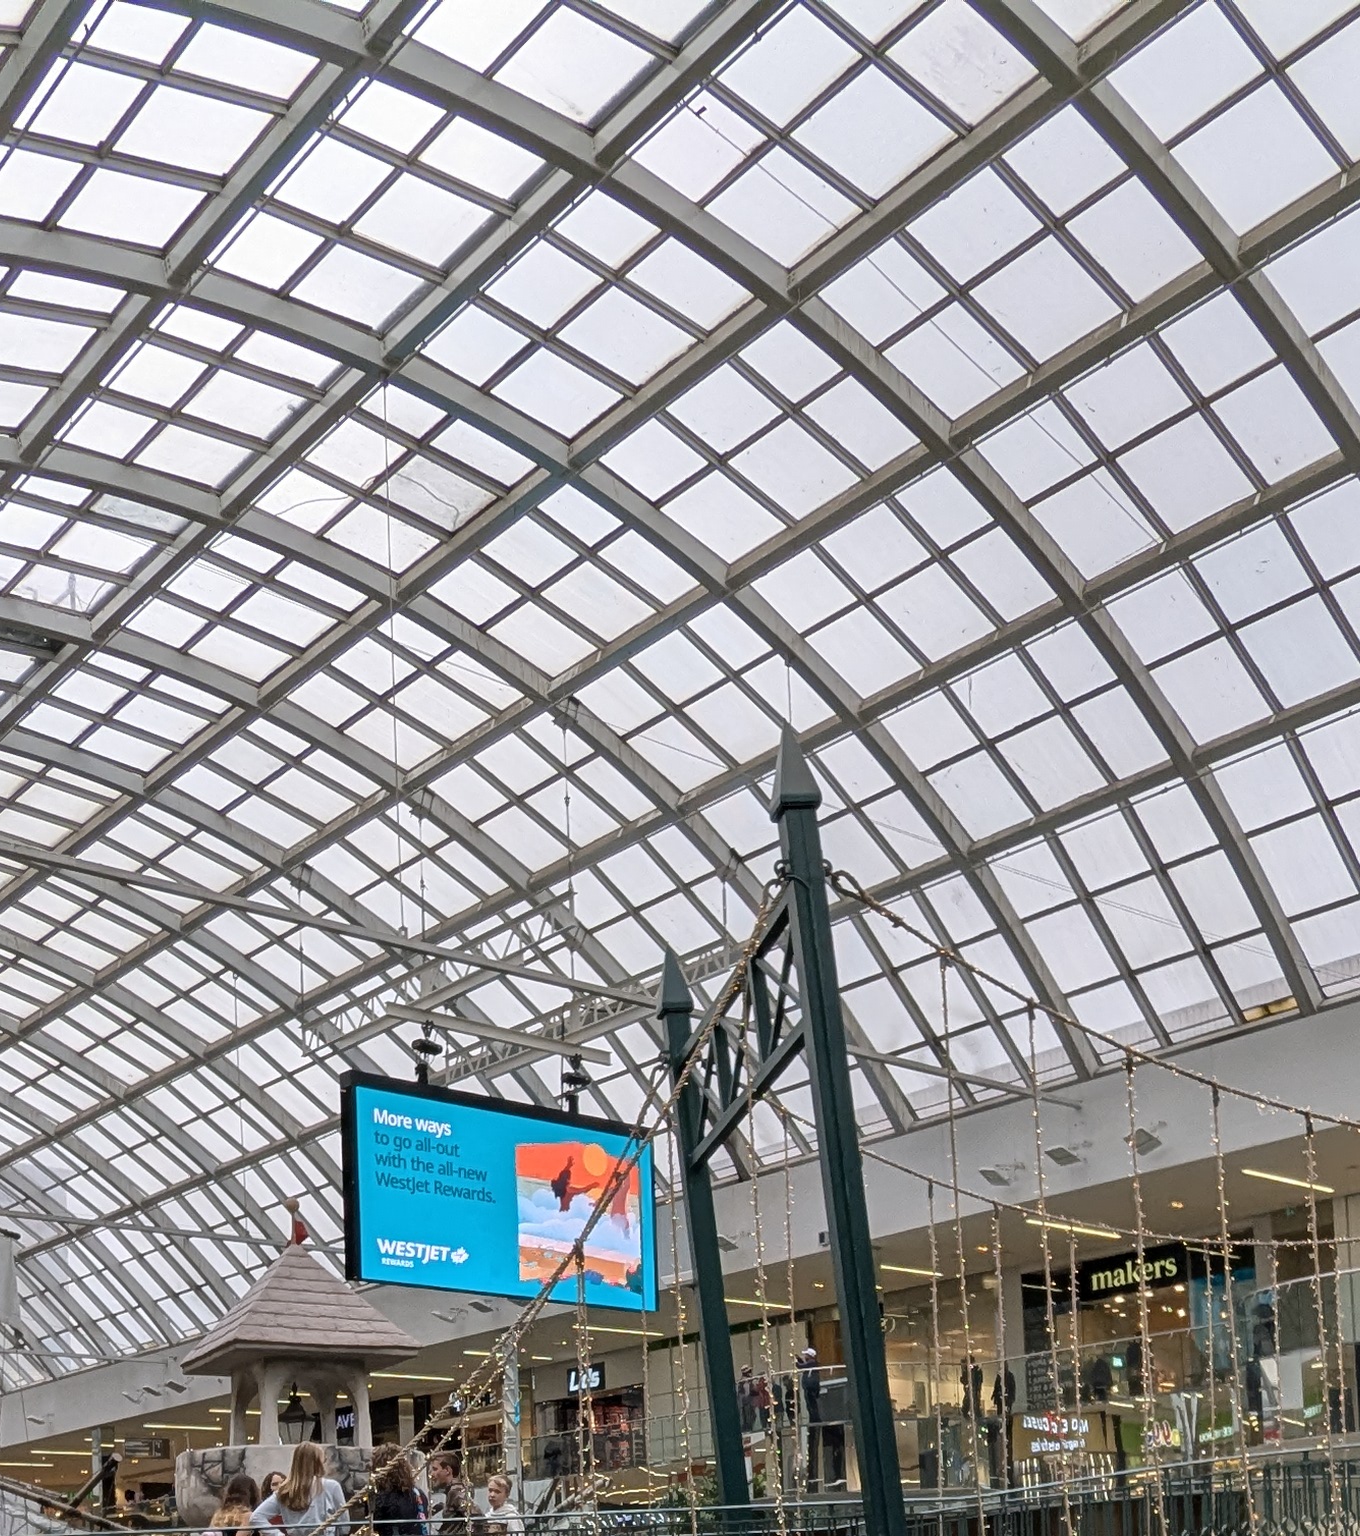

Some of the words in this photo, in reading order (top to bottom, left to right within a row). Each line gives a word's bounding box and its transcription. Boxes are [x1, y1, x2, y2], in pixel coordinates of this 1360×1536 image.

[373, 1107, 412, 1129] More
[415, 1118, 452, 1138] ways
[374, 1130, 390, 1146] to
[393, 1135, 412, 1152] go
[415, 1137, 460, 1158] all-out
[374, 1152, 407, 1169] with
[411, 1156, 434, 1174] the
[437, 1161, 488, 1182] all-new
[375, 1171, 431, 1195] WestJet
[434, 1180, 497, 1204] Rewards.
[376, 1237, 451, 1265] WESTJET
[381, 1257, 415, 1268] REWARDS
[1091, 1257, 1178, 1292] makers
